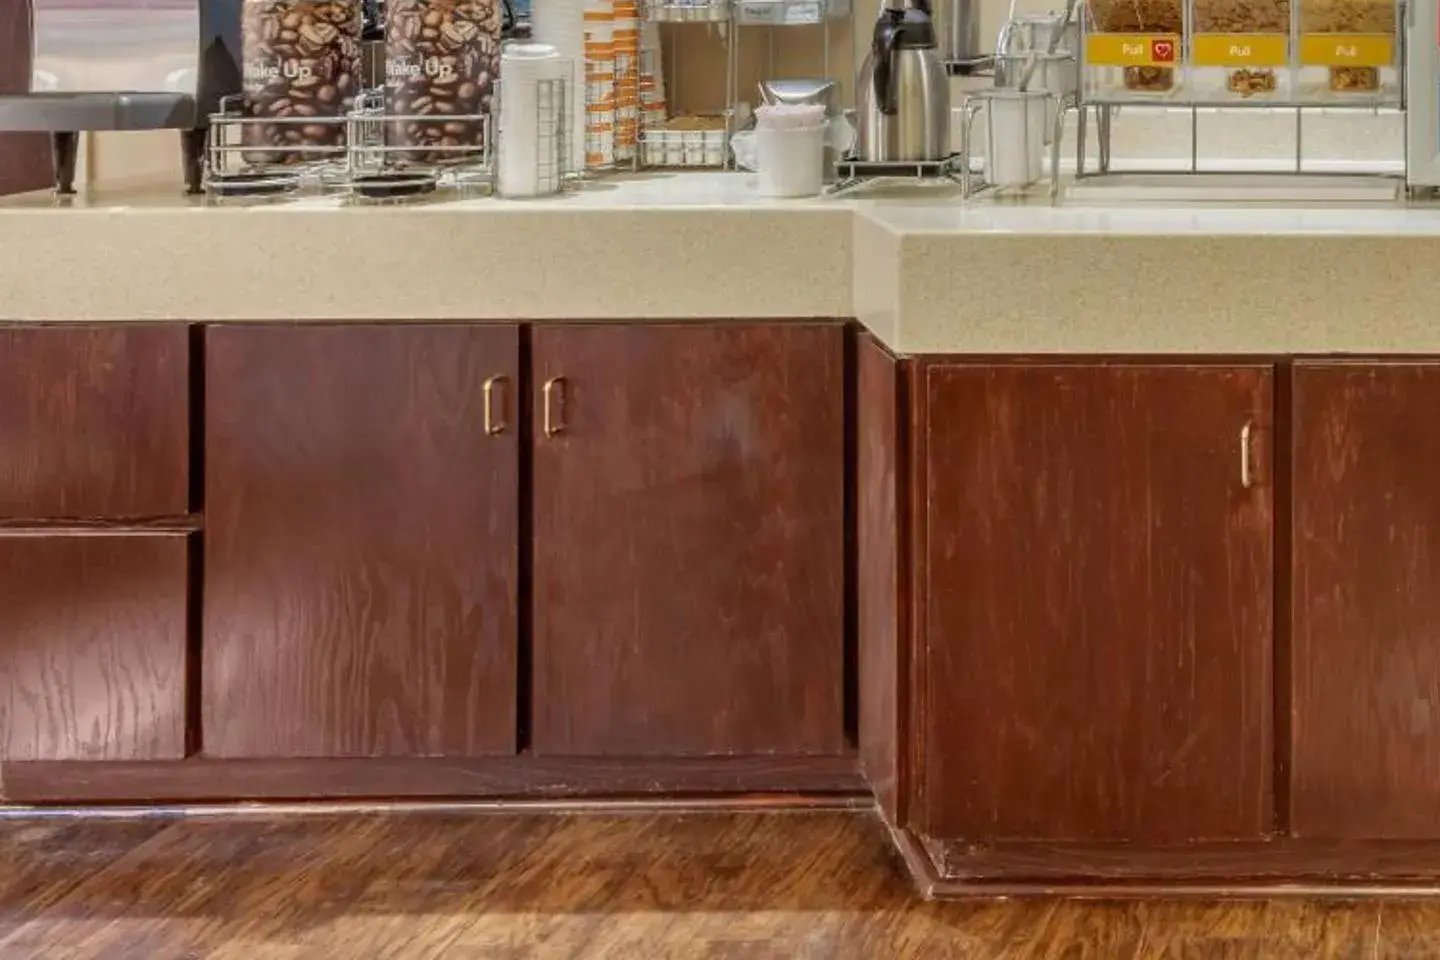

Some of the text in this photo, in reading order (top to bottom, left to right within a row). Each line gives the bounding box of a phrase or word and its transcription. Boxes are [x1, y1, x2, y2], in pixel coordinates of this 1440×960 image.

[1122, 43, 1144, 56] Pull
[1229, 46, 1251, 57] Pull
[283, 61, 312, 81] Up
[425, 57, 453, 78] Up
